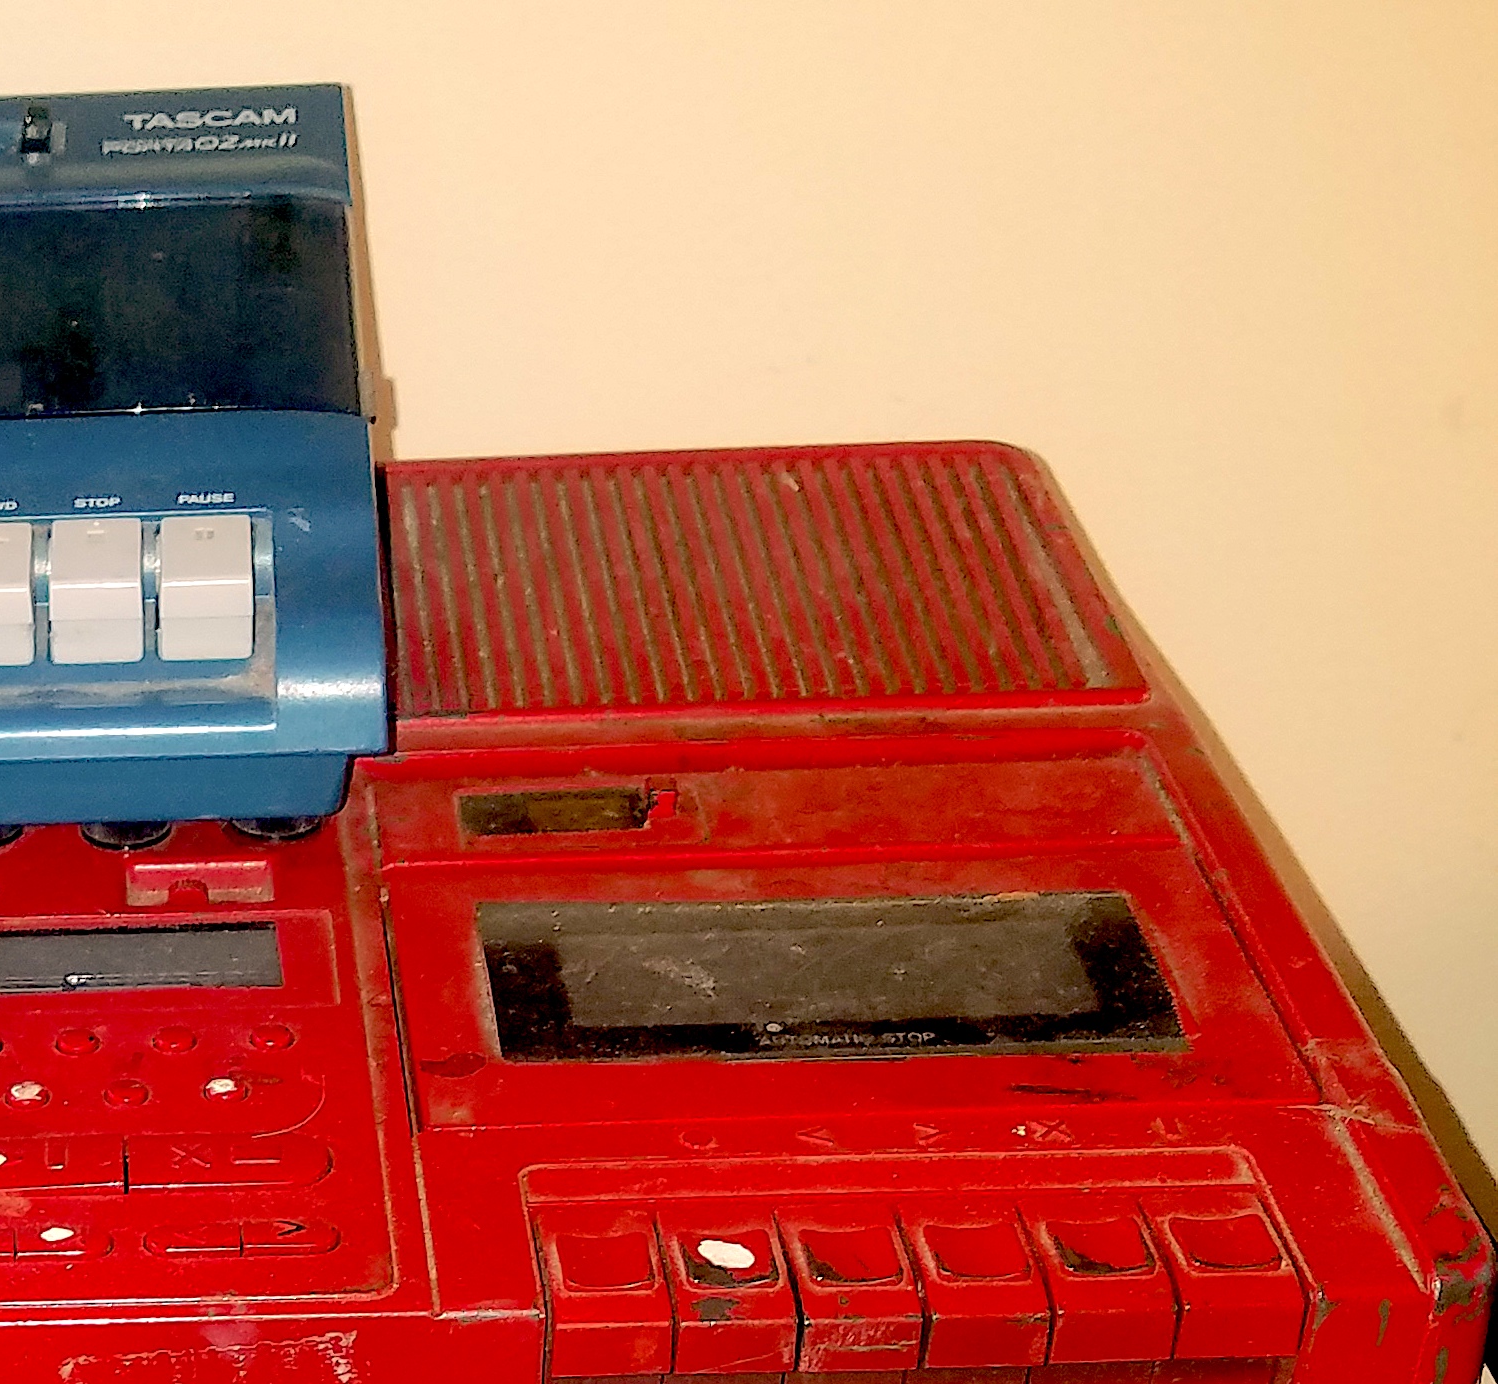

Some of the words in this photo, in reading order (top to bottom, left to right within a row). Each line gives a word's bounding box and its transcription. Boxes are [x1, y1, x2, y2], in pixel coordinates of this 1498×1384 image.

[124, 108, 298, 131] TASCAM
[74, 496, 121, 508] STOP
[177, 492, 235, 504] PAUSE
[882, 1031, 935, 1044] STOP
